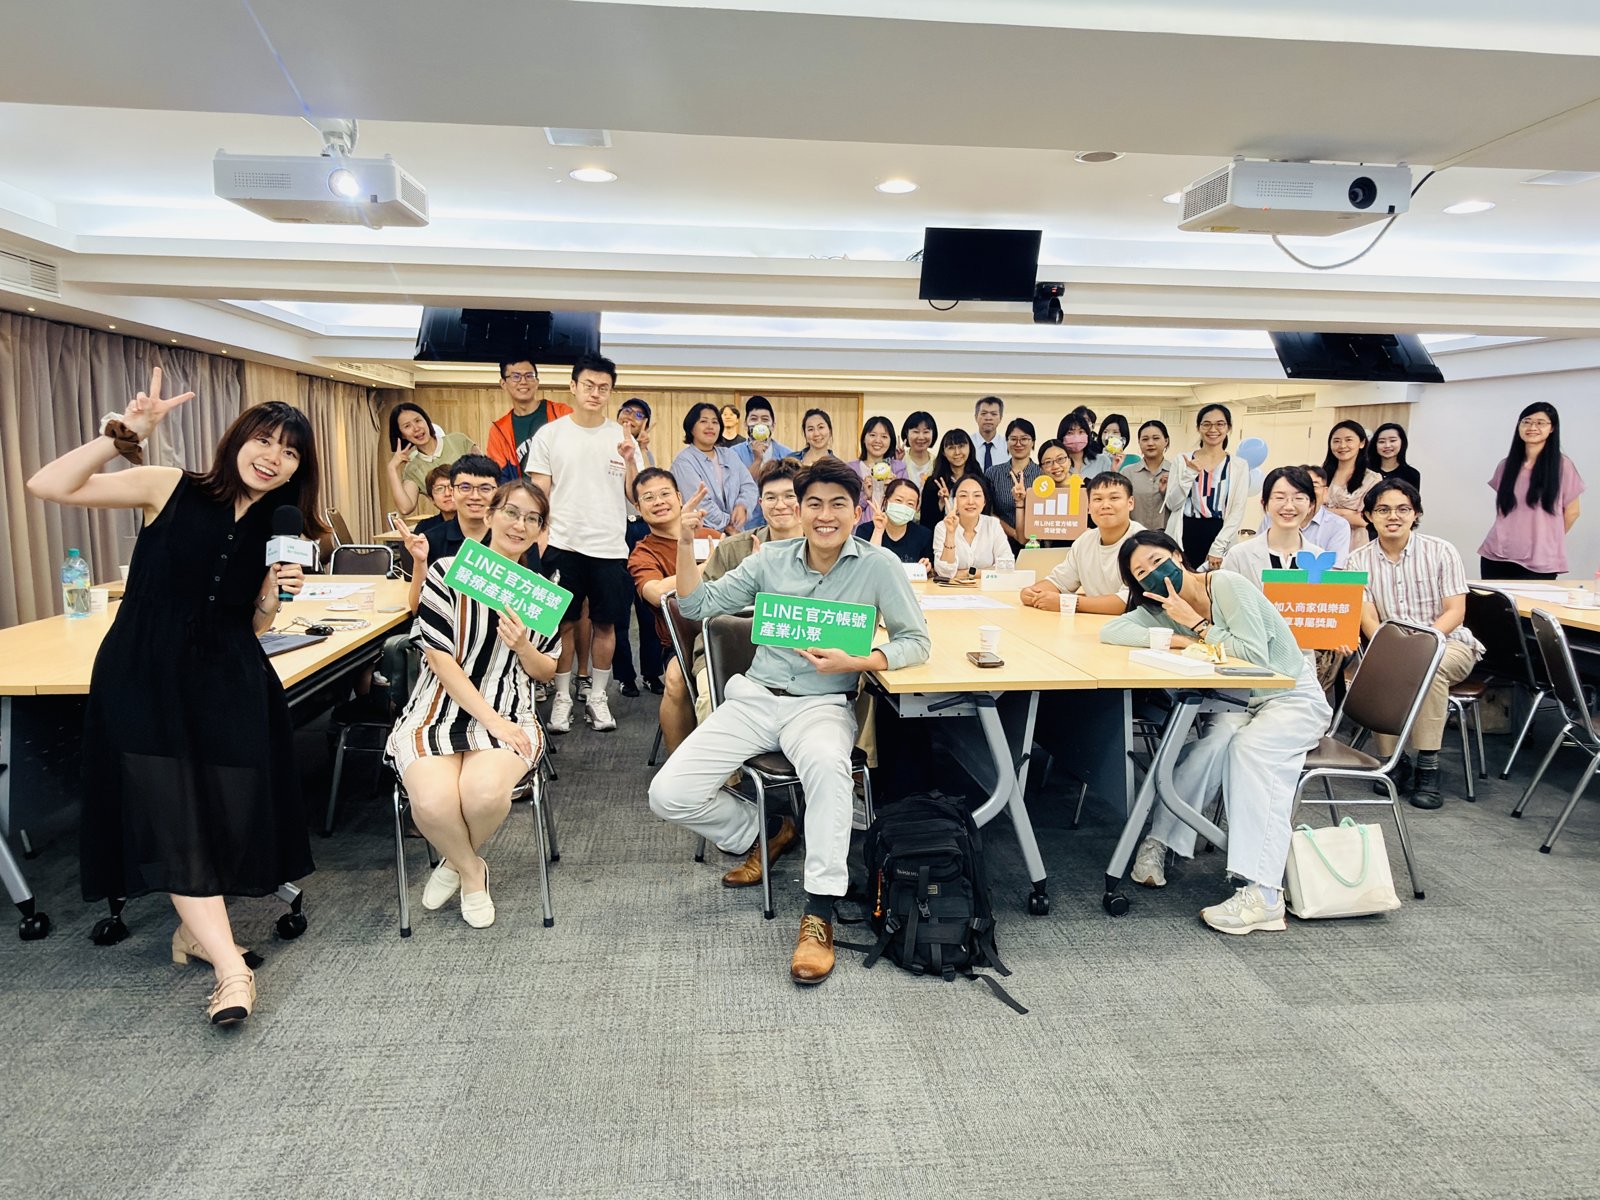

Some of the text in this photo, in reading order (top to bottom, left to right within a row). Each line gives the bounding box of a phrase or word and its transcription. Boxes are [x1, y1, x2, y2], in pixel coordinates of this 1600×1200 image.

[455, 565, 543, 621] 醫療產業小聚
[760, 621, 822, 642] 產業小聚
